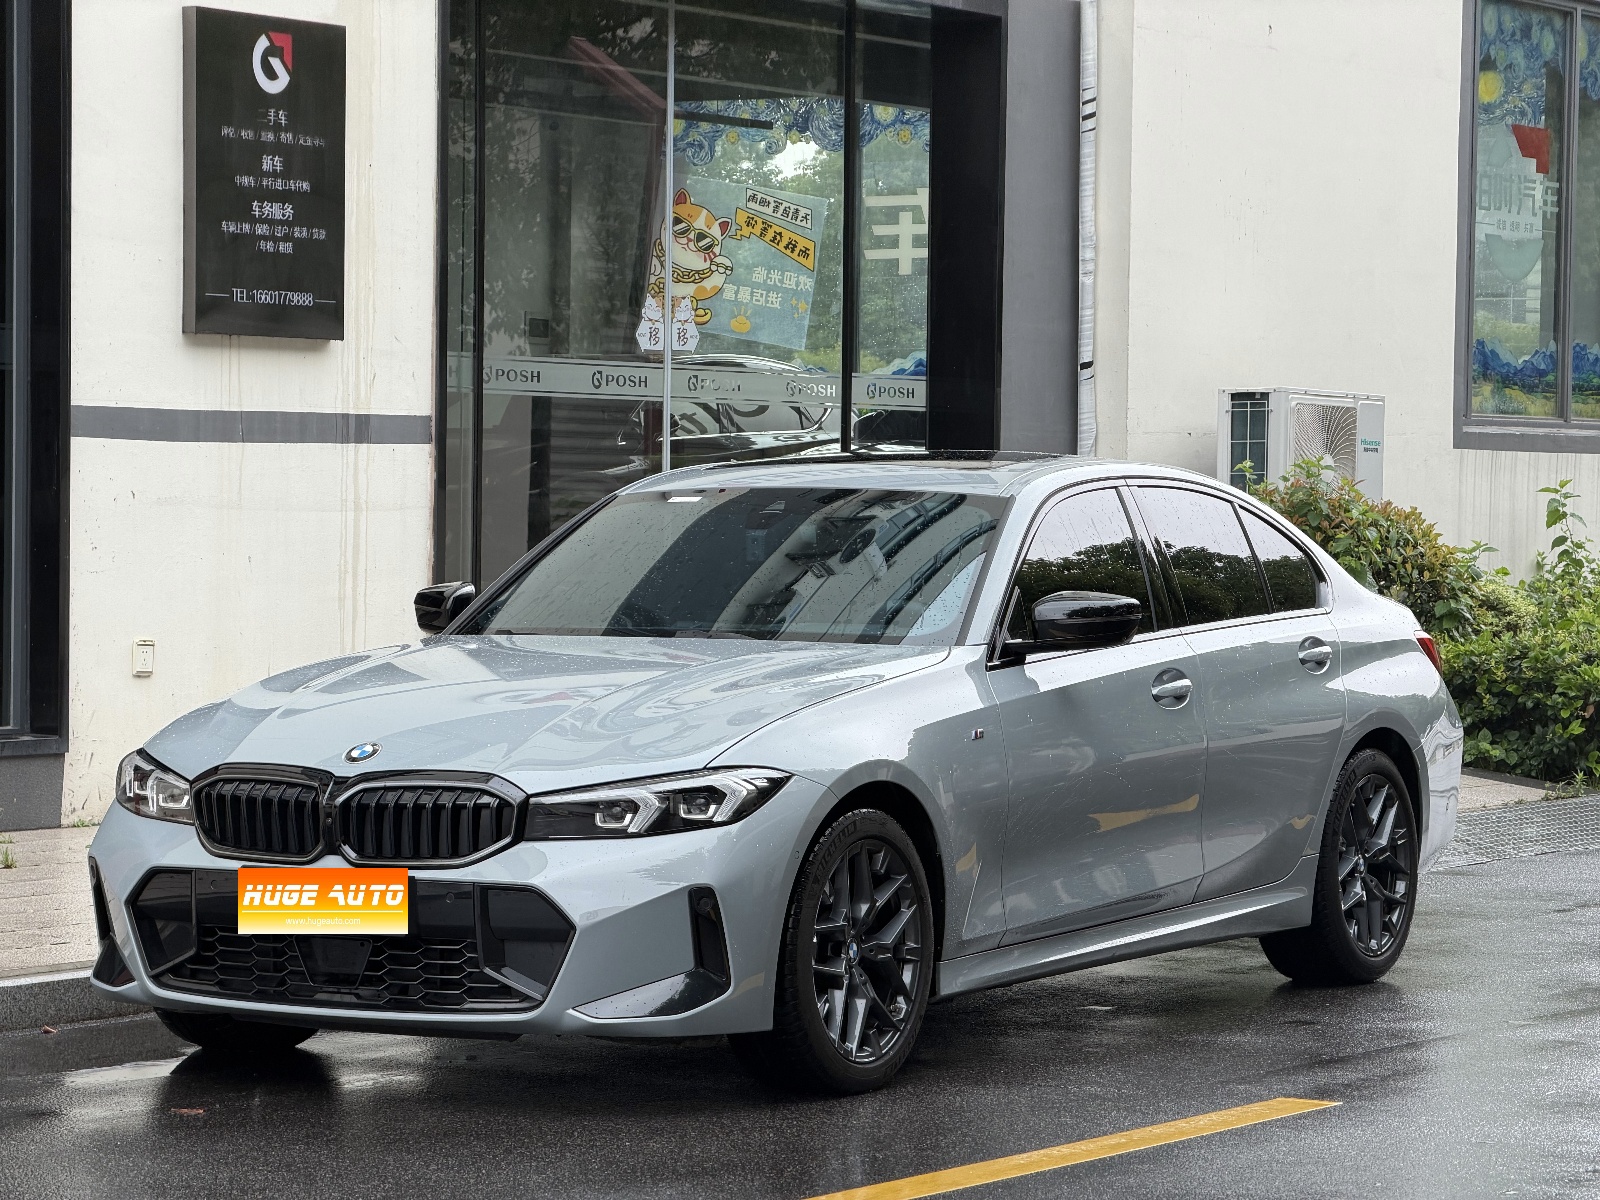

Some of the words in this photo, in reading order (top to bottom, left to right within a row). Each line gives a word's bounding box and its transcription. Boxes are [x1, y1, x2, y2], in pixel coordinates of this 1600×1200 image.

[257, 108, 288, 127] 二手车
[261, 154, 284, 173] 新车
[251, 200, 295, 221] 车务服务
[648, 326, 660, 347] 移
[676, 327, 689, 347] 移
[495, 368, 541, 384] POSH
[605, 373, 648, 389] POSH
[798, 382, 837, 398] POSH
[878, 385, 916, 399] POSH
